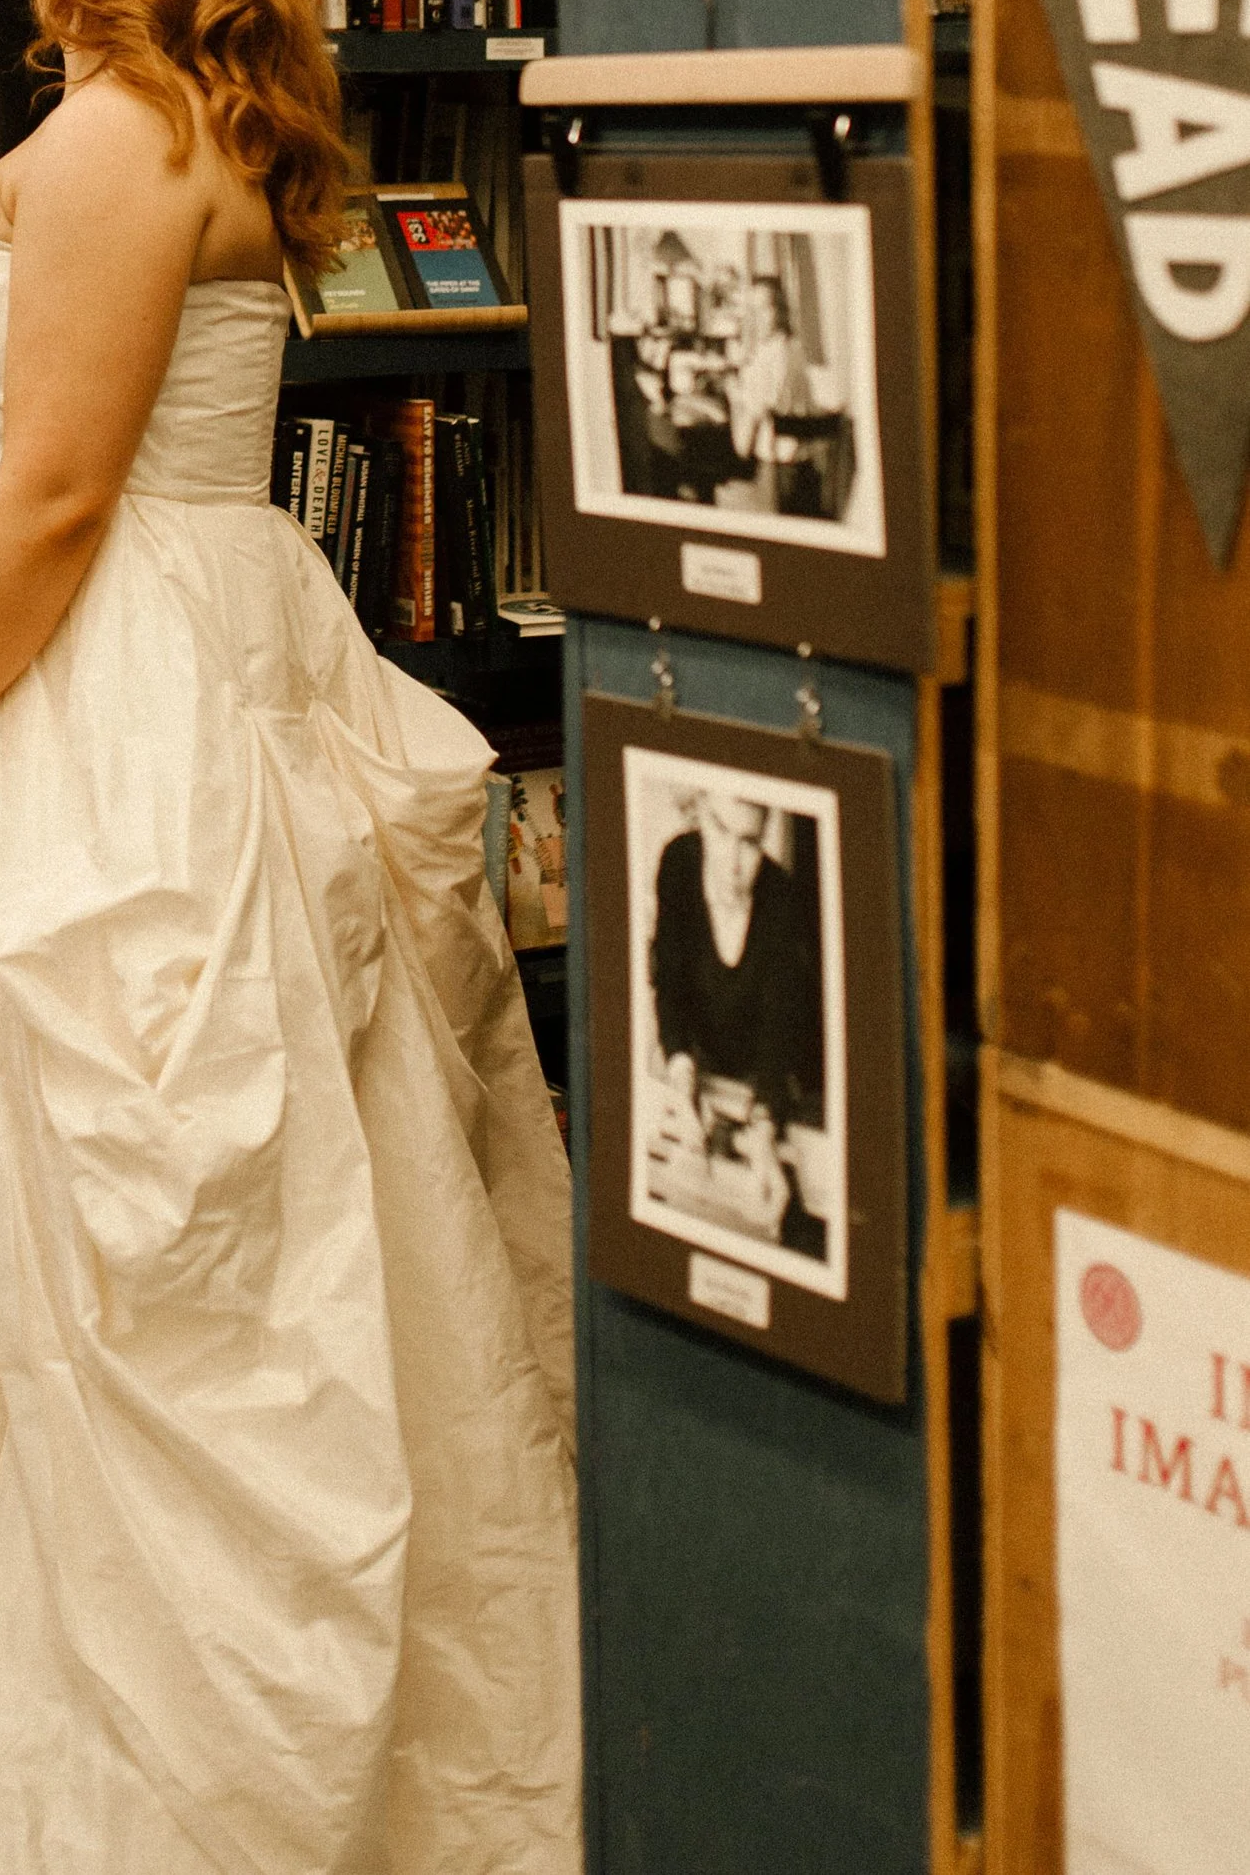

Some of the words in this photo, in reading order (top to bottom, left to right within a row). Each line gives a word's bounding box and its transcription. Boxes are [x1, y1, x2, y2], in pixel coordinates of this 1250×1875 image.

[423, 406, 431, 437] EASY
[315, 430, 329, 466] LOVE
[333, 434, 347, 474] MICHAEL
[423, 439, 431, 456] TO
[313, 468, 327, 485] &
[359, 460, 370, 487] SUSAN
[326, 476, 341, 534] BLOOMFIELD
[356, 488, 367, 522] WHITALL
[423, 457, 431, 524] REMEMBER
[310, 486, 324, 534] DEATH
[352, 527, 364, 559] WOMEN
[352, 561, 360, 572] OF
